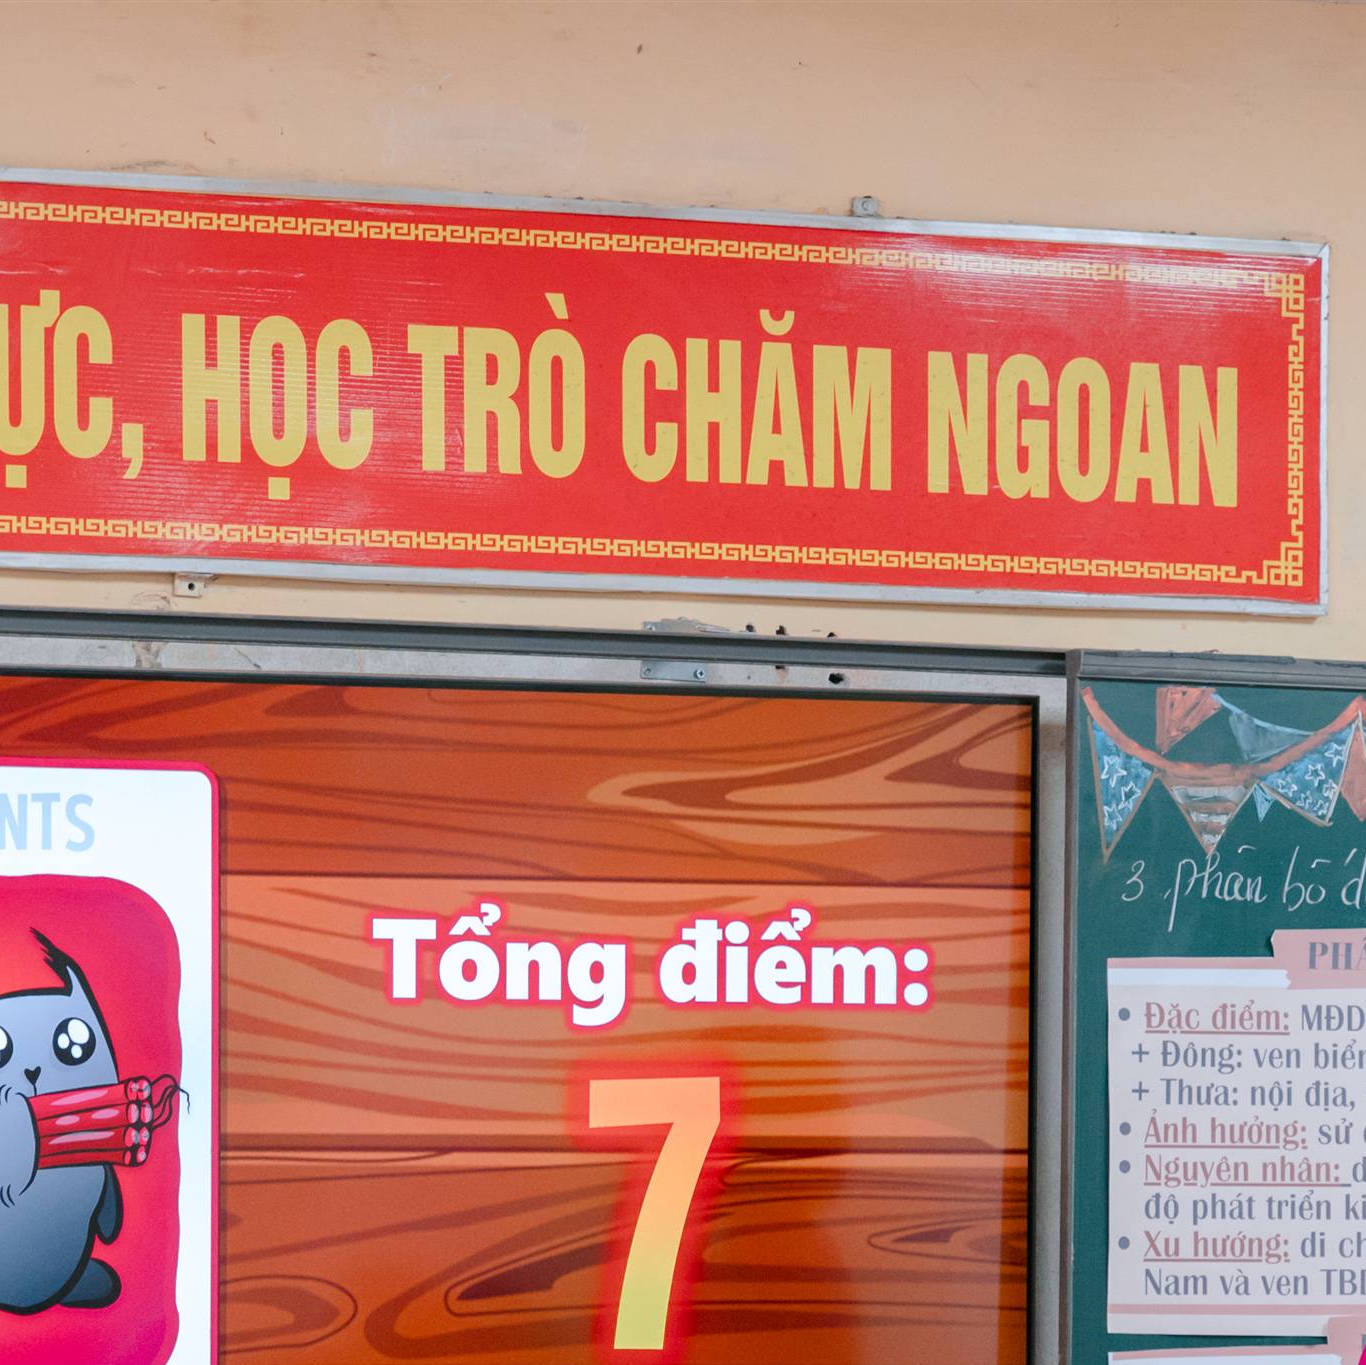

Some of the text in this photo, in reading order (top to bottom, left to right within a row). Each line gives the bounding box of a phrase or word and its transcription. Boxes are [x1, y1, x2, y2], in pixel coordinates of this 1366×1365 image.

[181, 312, 373, 501] HỌC
[407, 292, 586, 479] TRÒ
[621, 309, 893, 493] CHĂM
[926, 351, 1239, 508] NGOAN
[372, 903, 929, 1026] Tổng điểm:
[1145, 1002, 1200, 1033] Đặc
[1211, 1000, 1290, 1031] điểm:
[1161, 1041, 1242, 1075] Đông:
[1253, 1047, 1300, 1068] ven
[1160, 1078, 1238, 1106] Thưa:
[1250, 1080, 1292, 1111] nội
[1305, 1081, 1356, 1111] địa,
[1144, 1110, 1197, 1144] Ảnh
[1210, 1117, 1307, 1150] hưởng:
[1318, 1116, 1353, 1145] sử
[1145, 1154, 1249, 1187] Nguyên
[1262, 1157, 1340, 1183] nhân:
[588, 1076, 720, 1350] 7
[1144, 1193, 1179, 1224] độ
[1191, 1194, 1256, 1225] phát
[1266, 1189, 1332, 1221] triển
[1143, 1231, 1180, 1258] Xu
[1193, 1231, 1290, 1265] hướng:
[1300, 1232, 1326, 1258] di
[1144, 1268, 1208, 1296] Nam
[1220, 1269, 1251, 1296] và
[1260, 1276, 1308, 1296] ven
